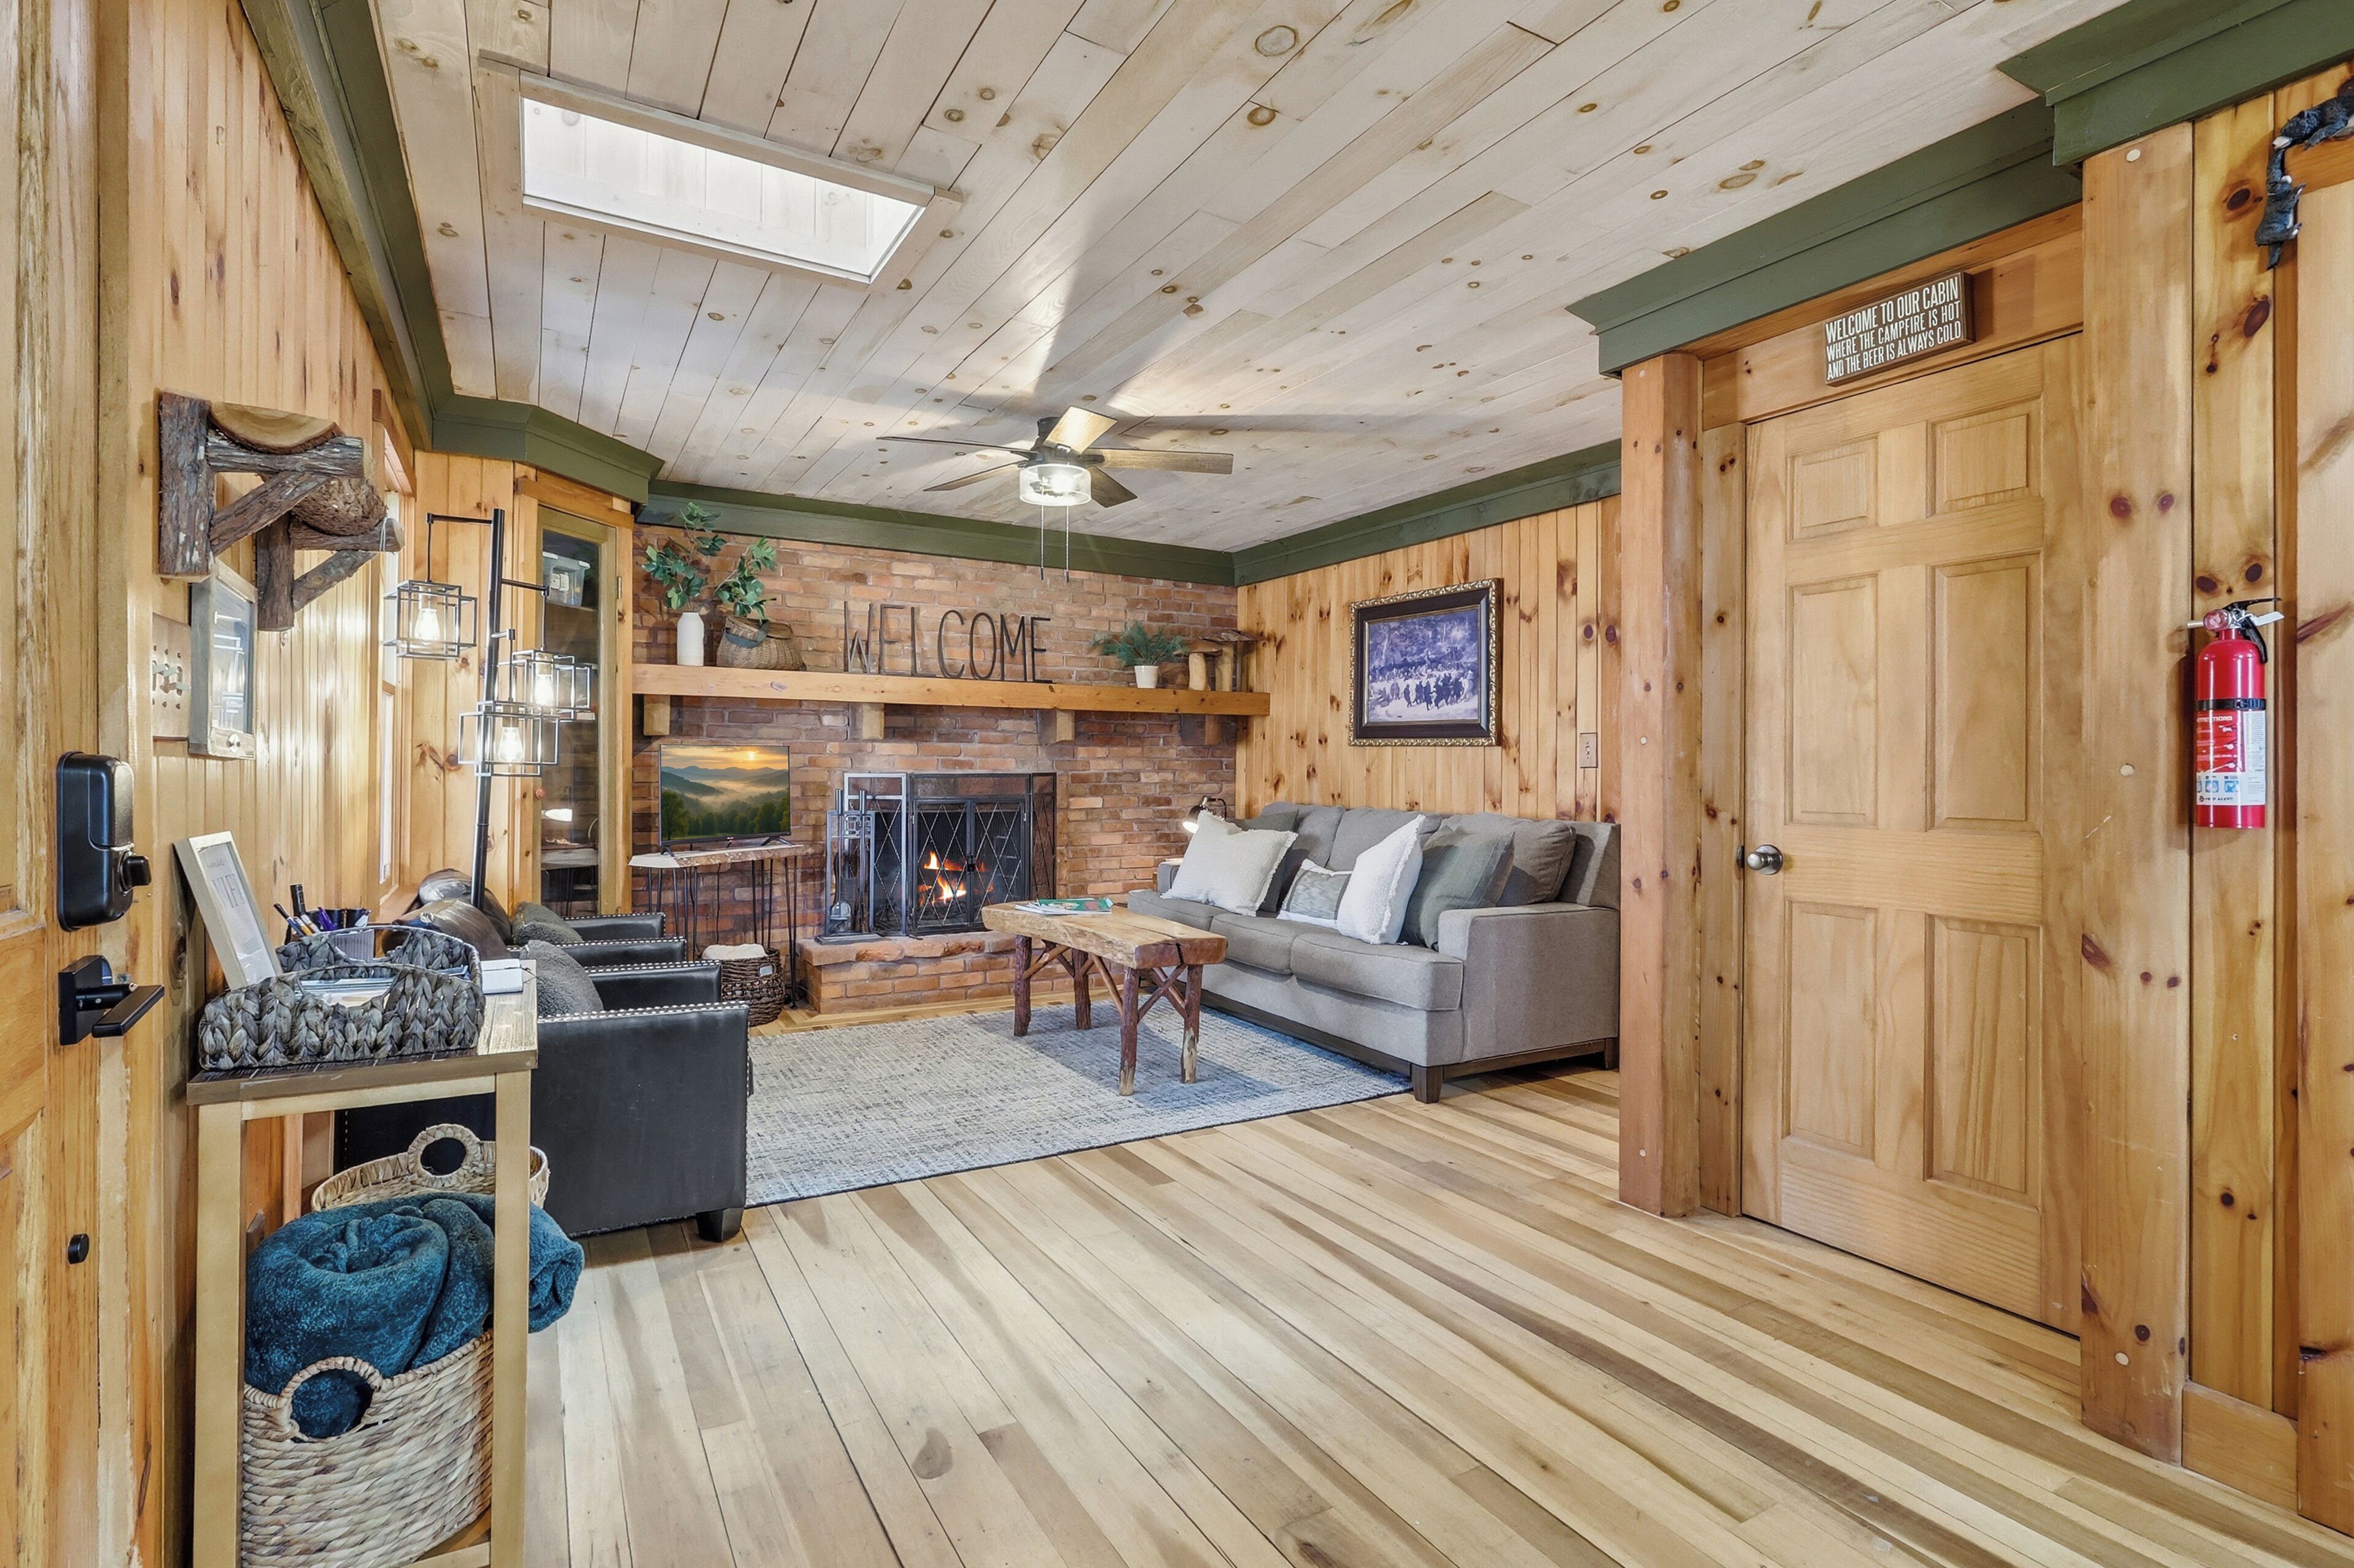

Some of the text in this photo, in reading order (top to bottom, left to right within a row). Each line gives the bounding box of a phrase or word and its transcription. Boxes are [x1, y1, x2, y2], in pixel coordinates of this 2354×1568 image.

[1826, 276, 1958, 343] WELCOME TO OUR CABIN
[1827, 300, 1960, 362] WHERE THE CAMPFIRE IS HOT
[1827, 321, 1961, 381] AND THE BEER IS ALWAYS COLD
[843, 601, 1056, 683] WELCOME
